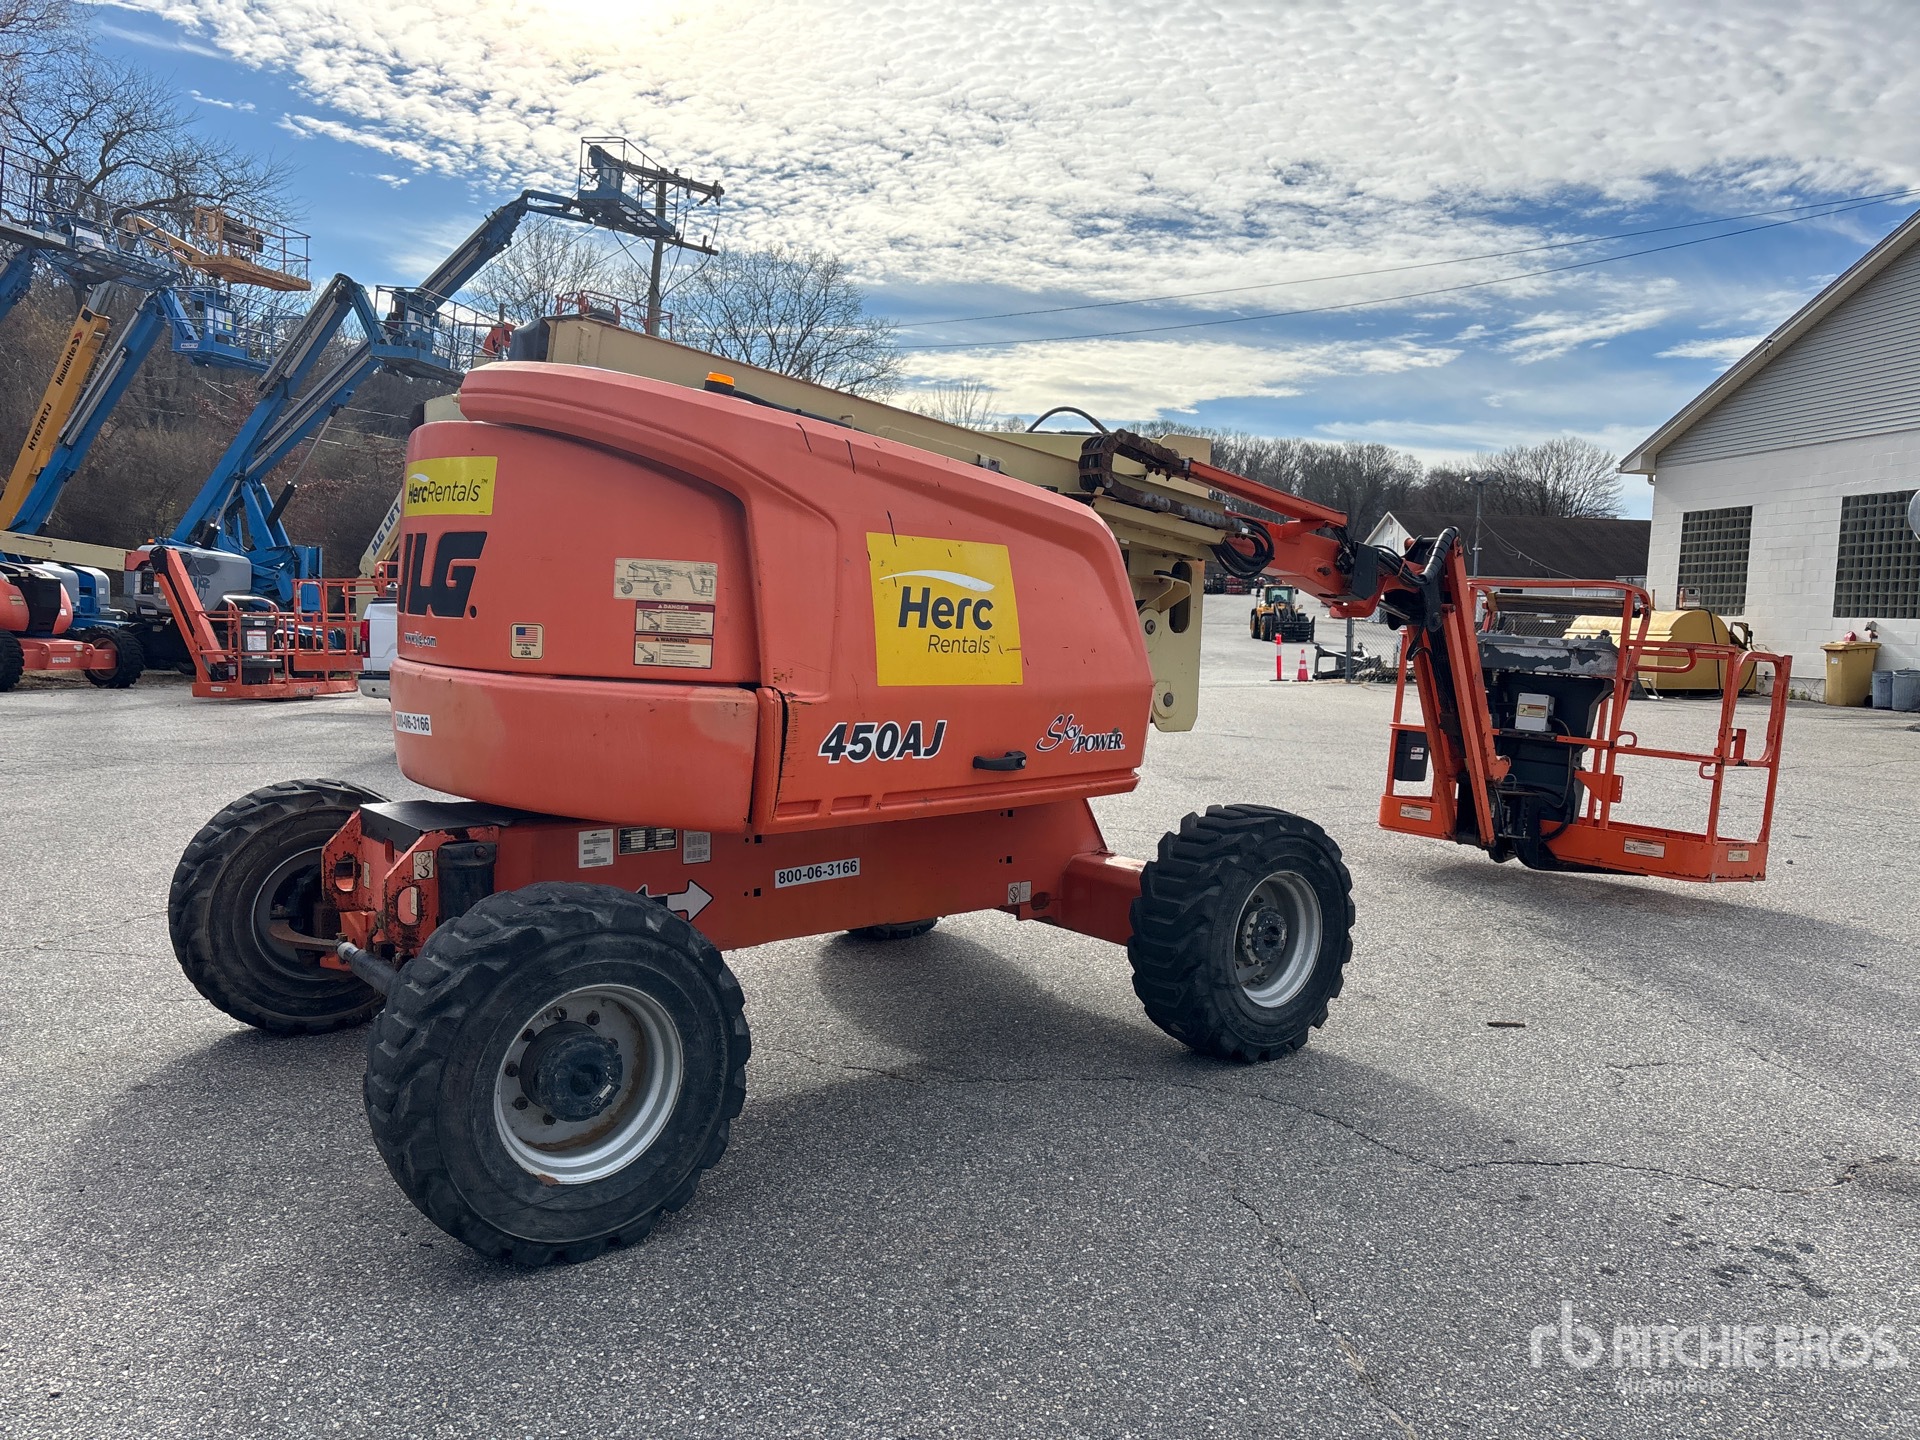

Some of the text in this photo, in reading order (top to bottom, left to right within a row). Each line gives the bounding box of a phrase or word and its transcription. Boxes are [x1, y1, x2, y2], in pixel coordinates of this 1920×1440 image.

[55, 347, 77, 386] Haulotte
[28, 402, 52, 451] HT67RTJ
[371, 502, 400, 556] JLG LIFT
[898, 586, 994, 631] Herc
[818, 720, 947, 764] 450AJ
[1035, 713, 1084, 754] Sky
[777, 860, 858, 885] 800-06-3166
